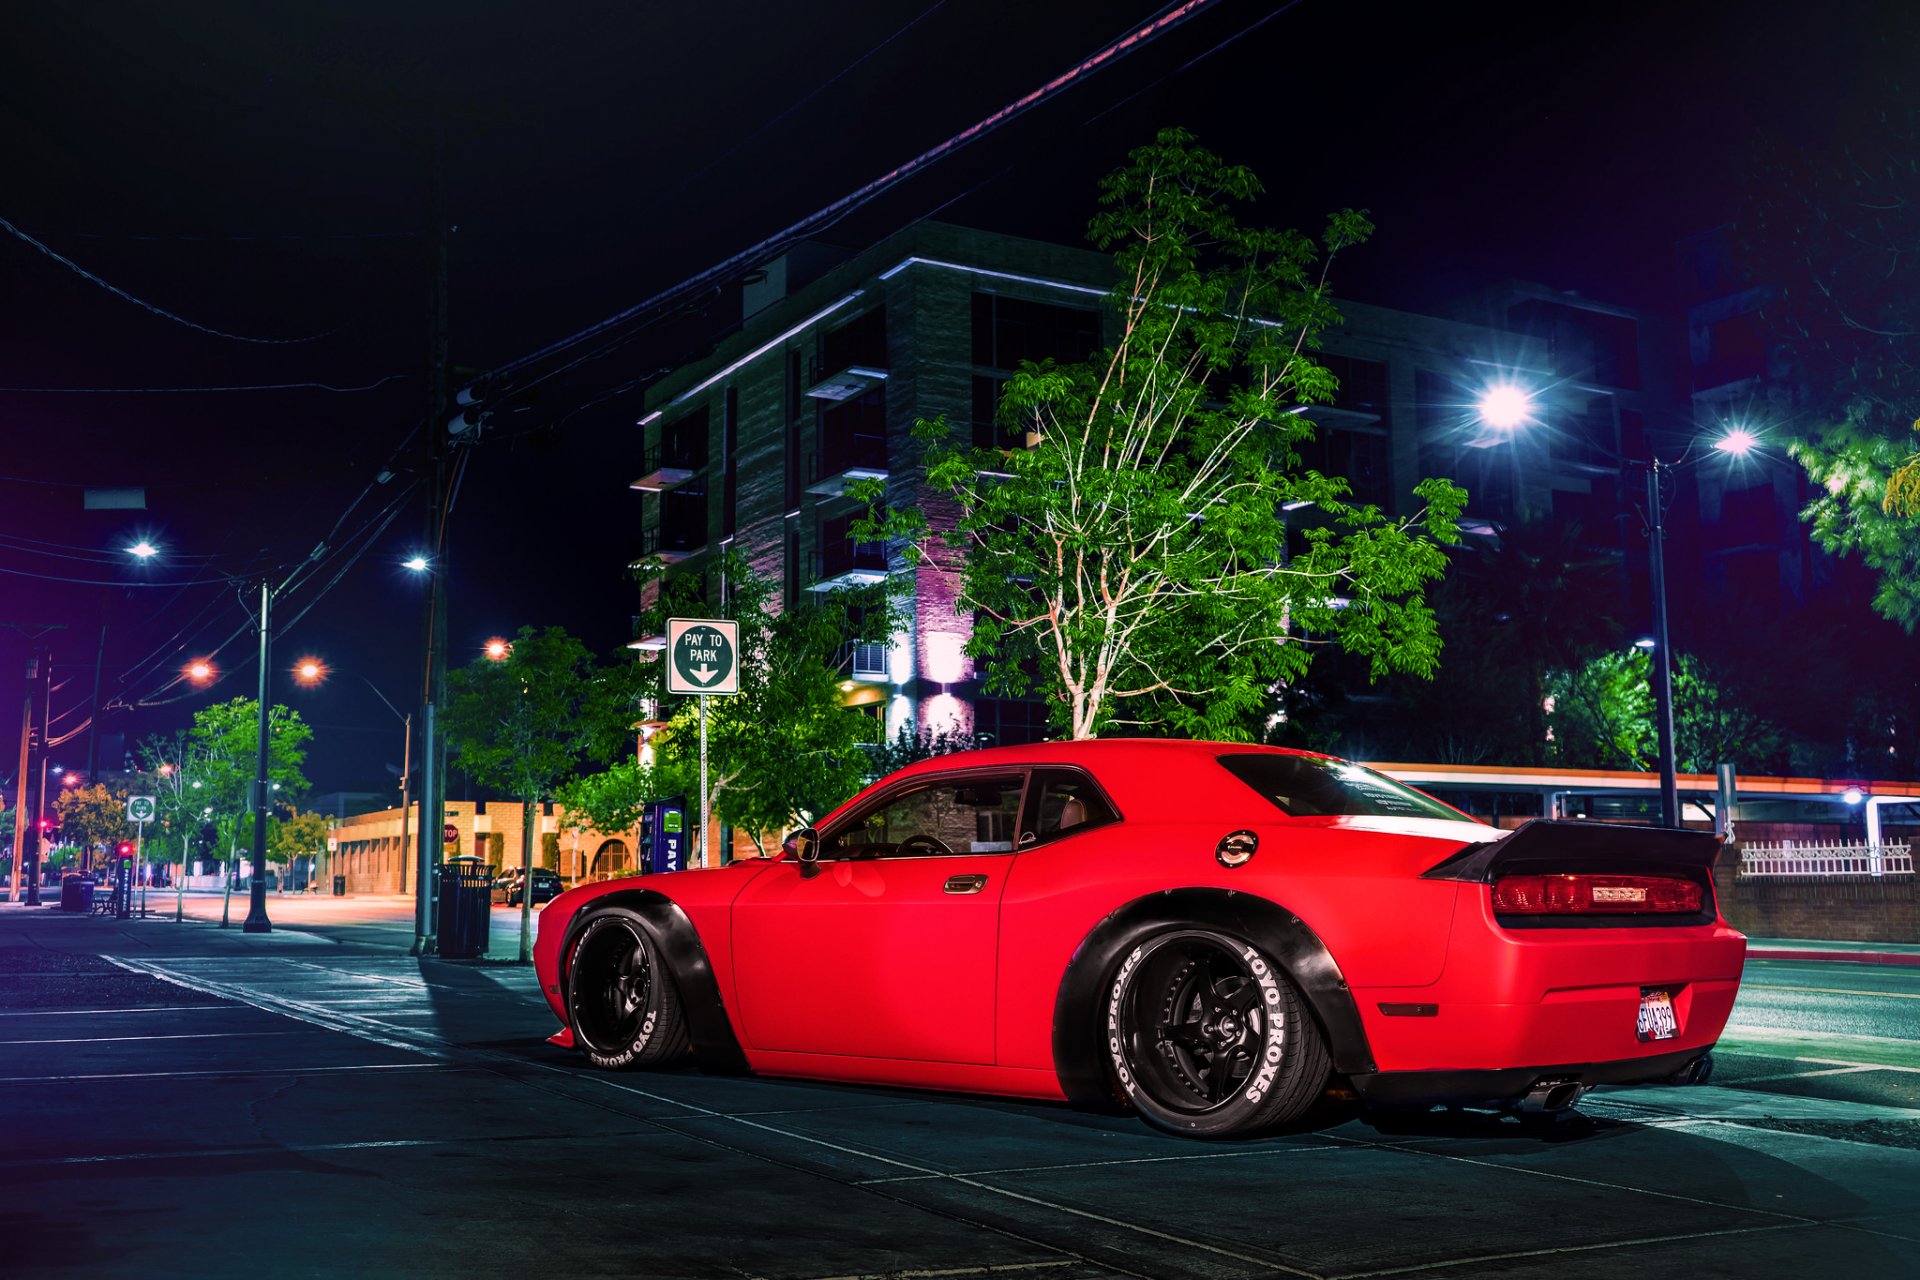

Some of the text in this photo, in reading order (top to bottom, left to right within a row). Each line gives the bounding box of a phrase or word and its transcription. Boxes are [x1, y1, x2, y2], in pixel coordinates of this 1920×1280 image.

[684, 633, 722, 647] PAY TO
[690, 649, 717, 662] PARK
[444, 829, 458, 838] TOP
[667, 839, 677, 871] PAY
[1108, 945, 1142, 1097] TOYO PROXES
[1244, 946, 1285, 1104] TOYO PROXES
[590, 1010, 657, 1068] TOYO PROXES
